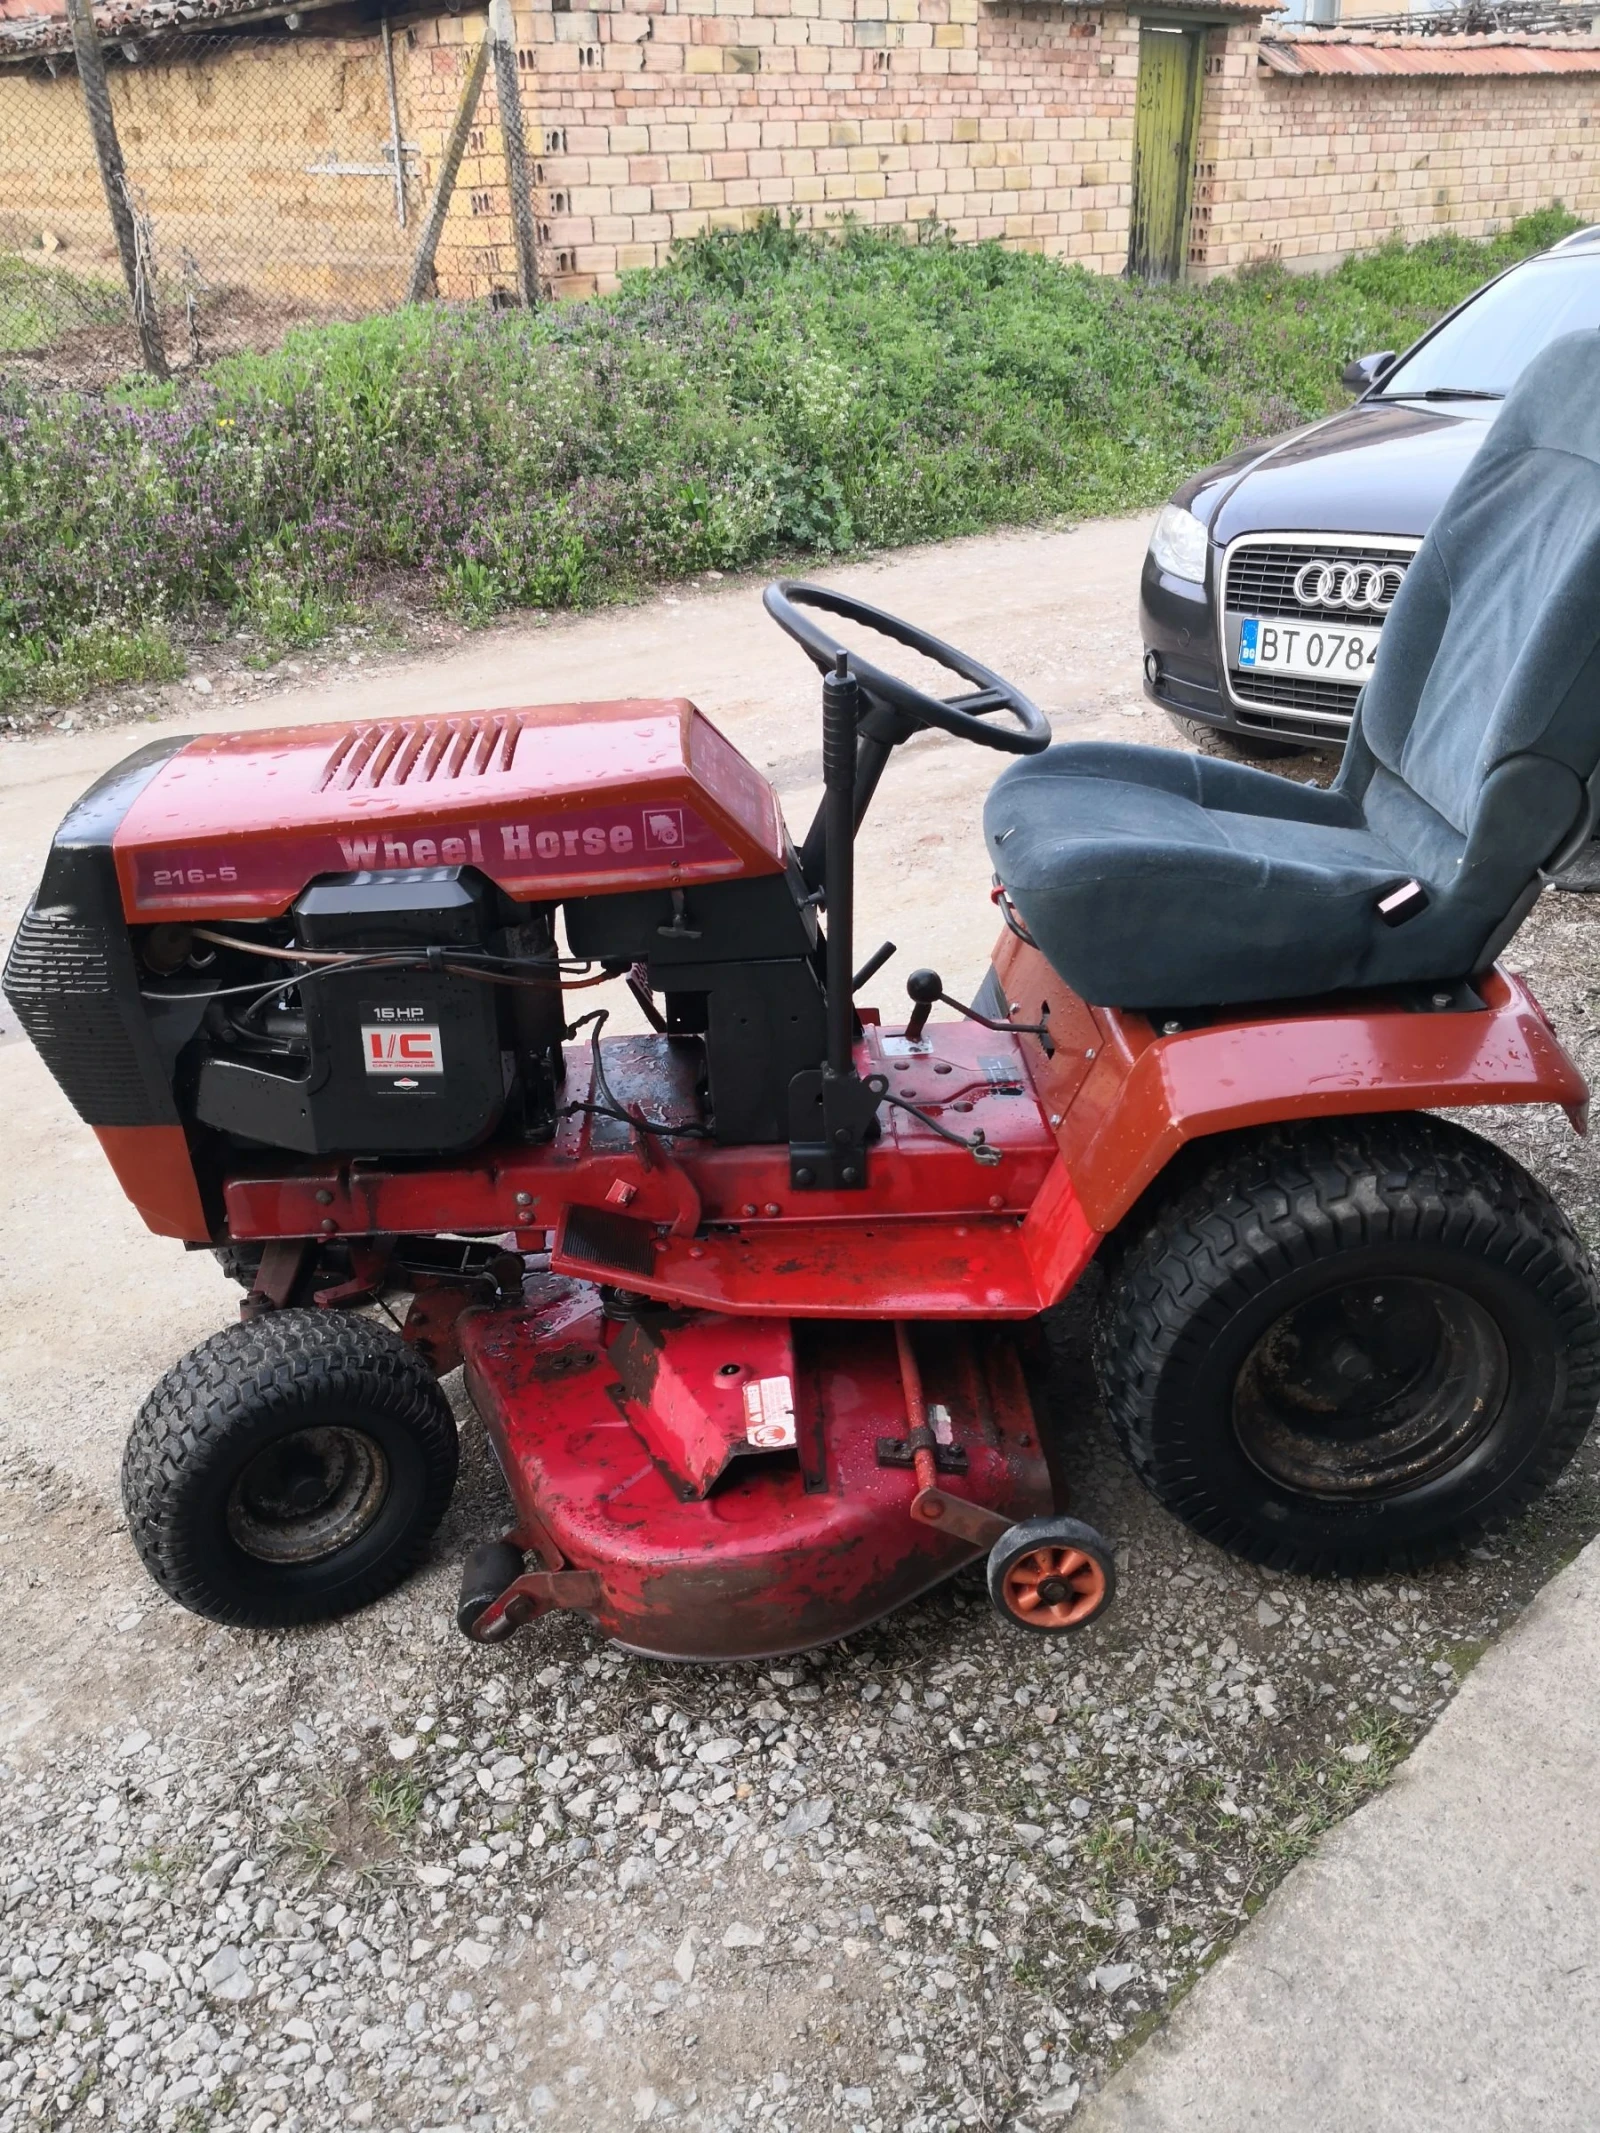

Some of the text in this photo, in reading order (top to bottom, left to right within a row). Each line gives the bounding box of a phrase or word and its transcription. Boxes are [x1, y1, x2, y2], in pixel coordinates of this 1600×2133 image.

[1242, 647, 1256, 659] BG
[1261, 628, 1300, 664] BT
[337, 824, 635, 870] Wheel Horse
[153, 866, 238, 886] 216-5
